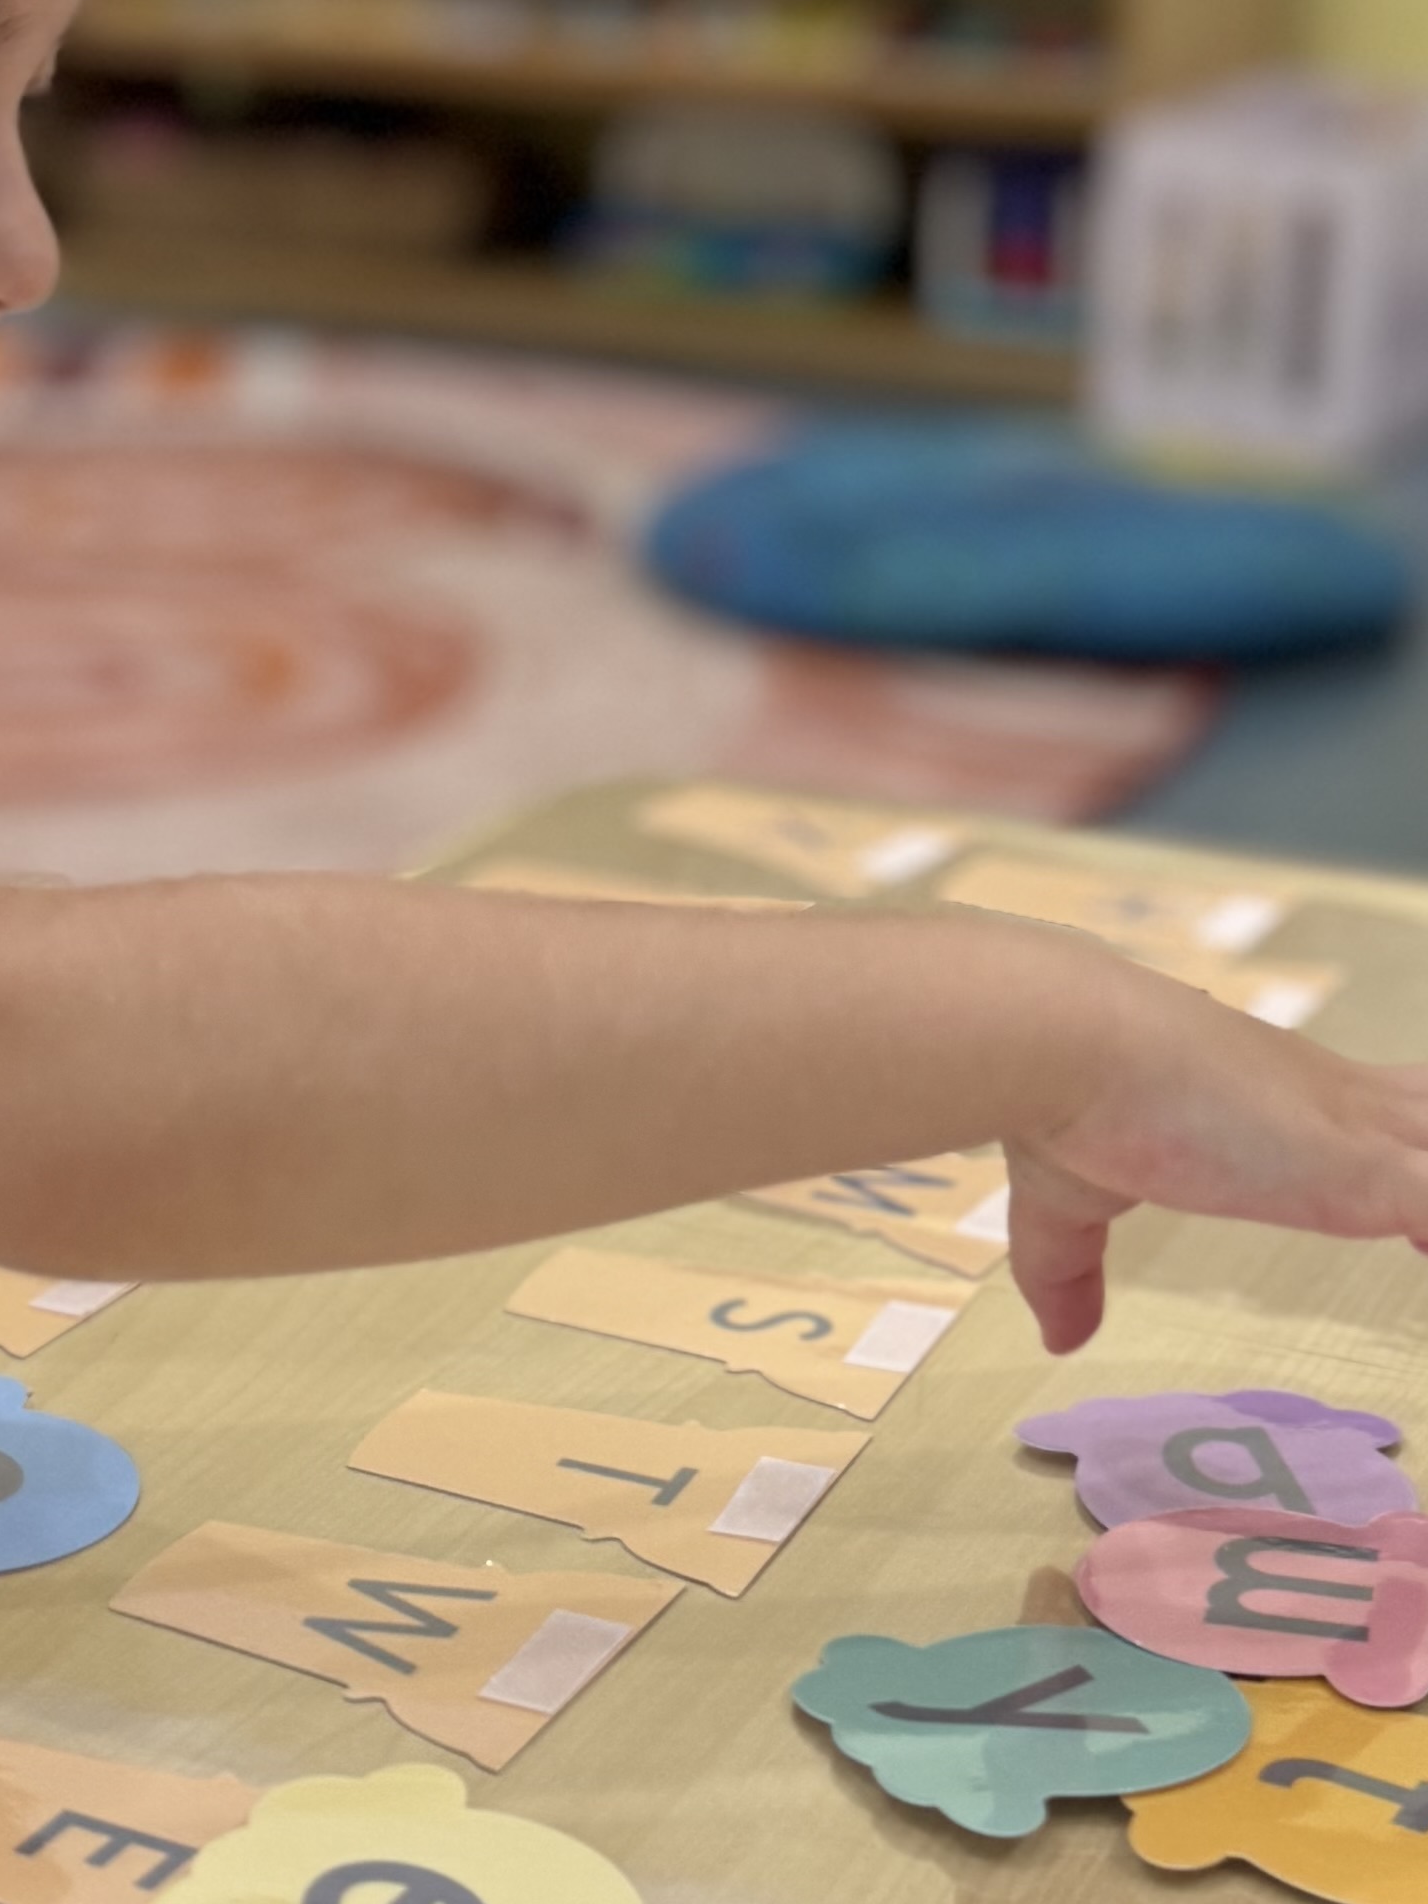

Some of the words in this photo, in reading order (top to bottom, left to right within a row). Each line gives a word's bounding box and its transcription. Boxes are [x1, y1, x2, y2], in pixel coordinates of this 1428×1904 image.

[708, 1298, 832, 1342] S
[557, 1457, 699, 1507] T
[1203, 1536, 1380, 1643] m
[868, 1663, 1150, 1734] y
[14, 1810, 199, 1891] E
